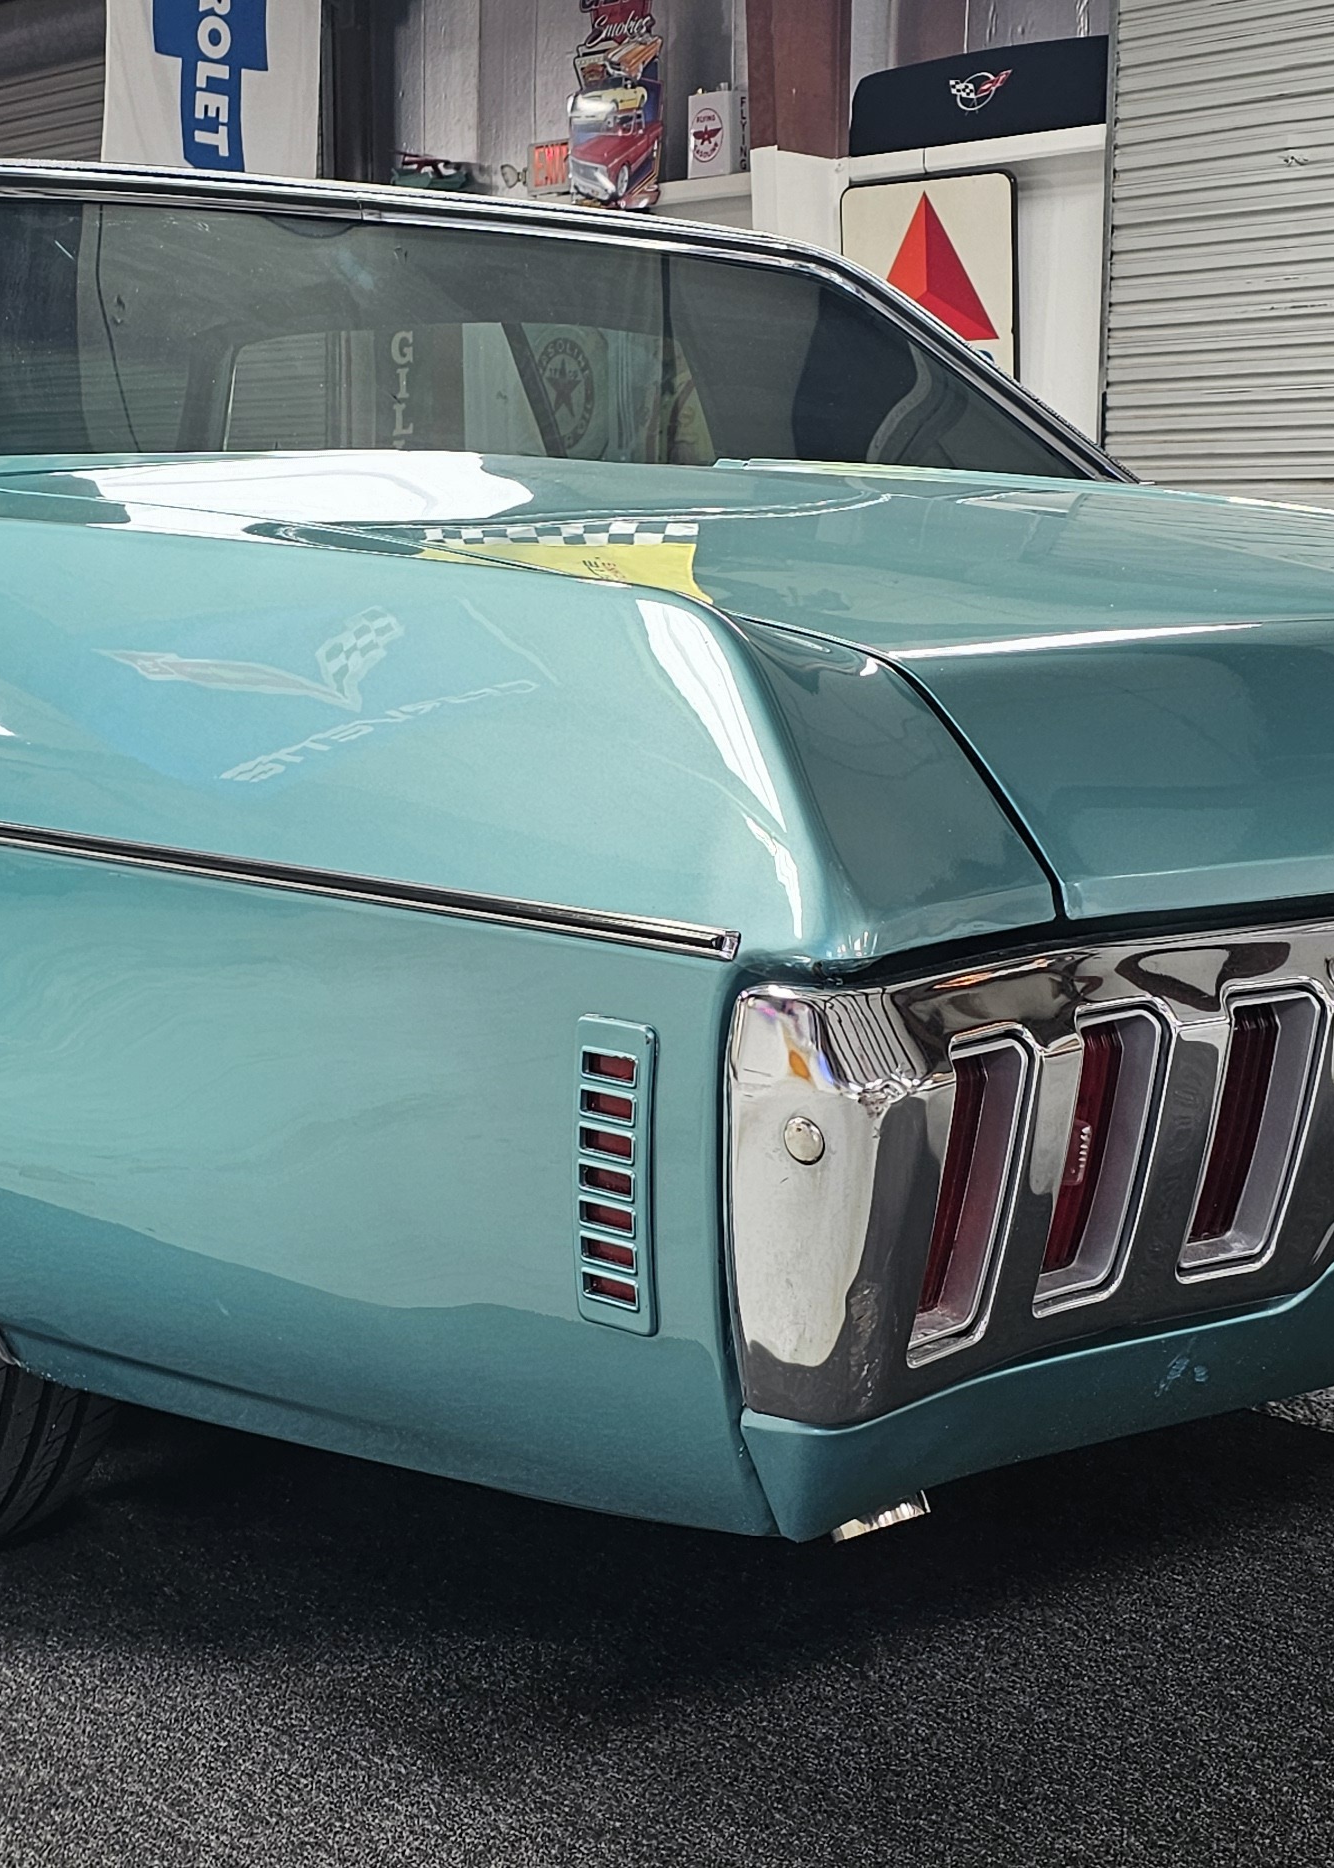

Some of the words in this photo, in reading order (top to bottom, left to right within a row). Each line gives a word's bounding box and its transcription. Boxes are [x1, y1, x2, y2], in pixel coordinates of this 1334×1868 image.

[586, 10, 651, 47] Smokies
[739, 96, 748, 171] FLYING
[391, 331, 414, 449] GIL
